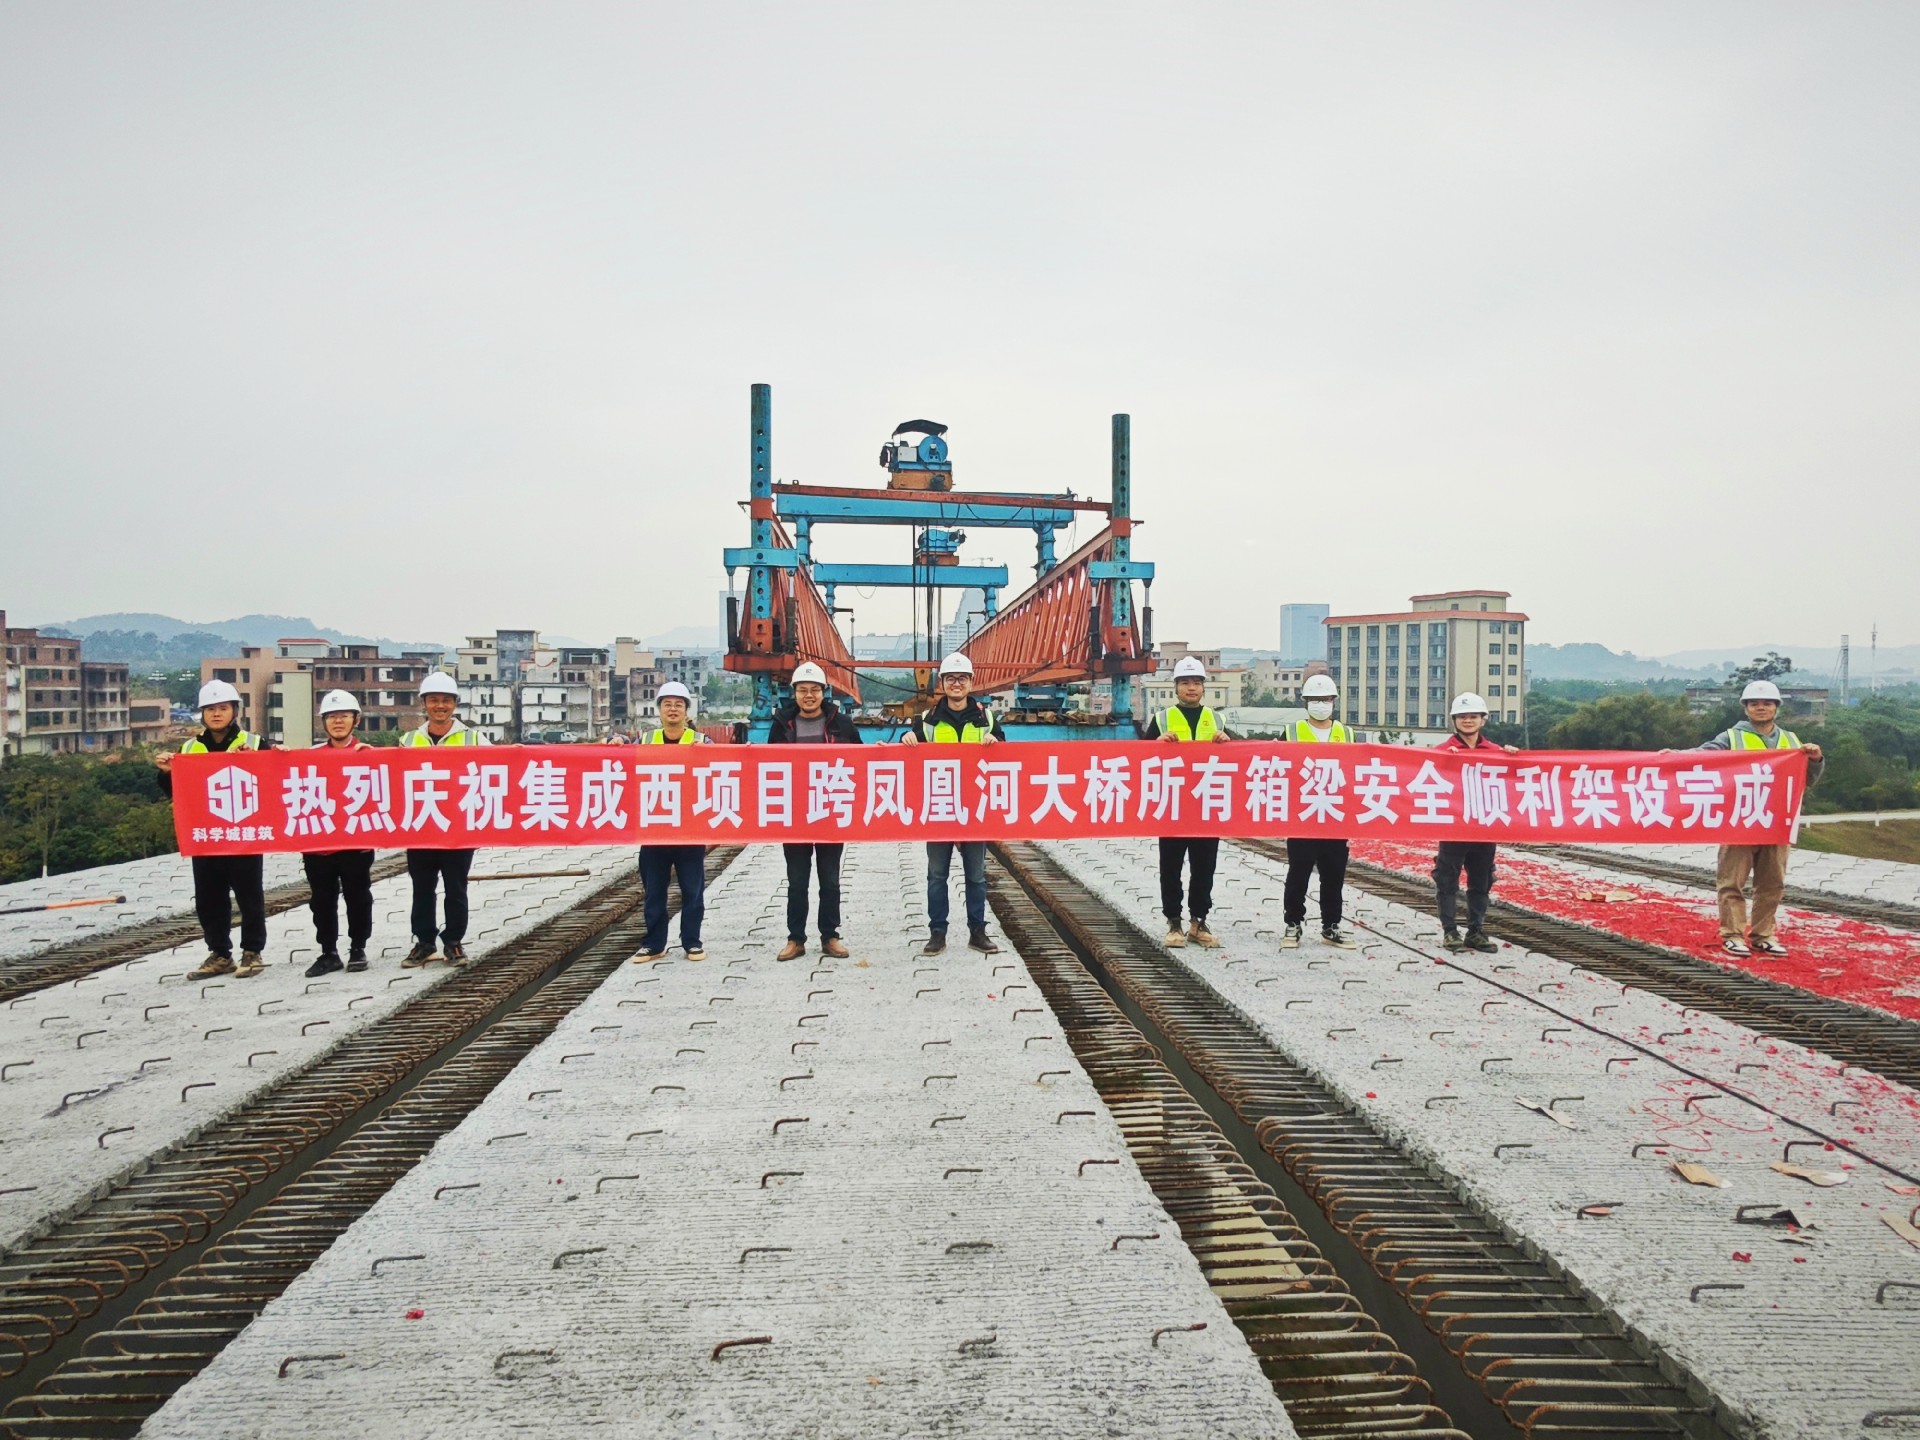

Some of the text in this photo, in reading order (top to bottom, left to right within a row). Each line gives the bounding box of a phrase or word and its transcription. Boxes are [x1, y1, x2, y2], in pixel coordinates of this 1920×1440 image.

[281, 755, 1794, 837] 热烈庆祝集成西项目跨凤凰河大桥所有箱梁安全顺利架设完成！
[192, 825, 275, 843] 科学城建筑
